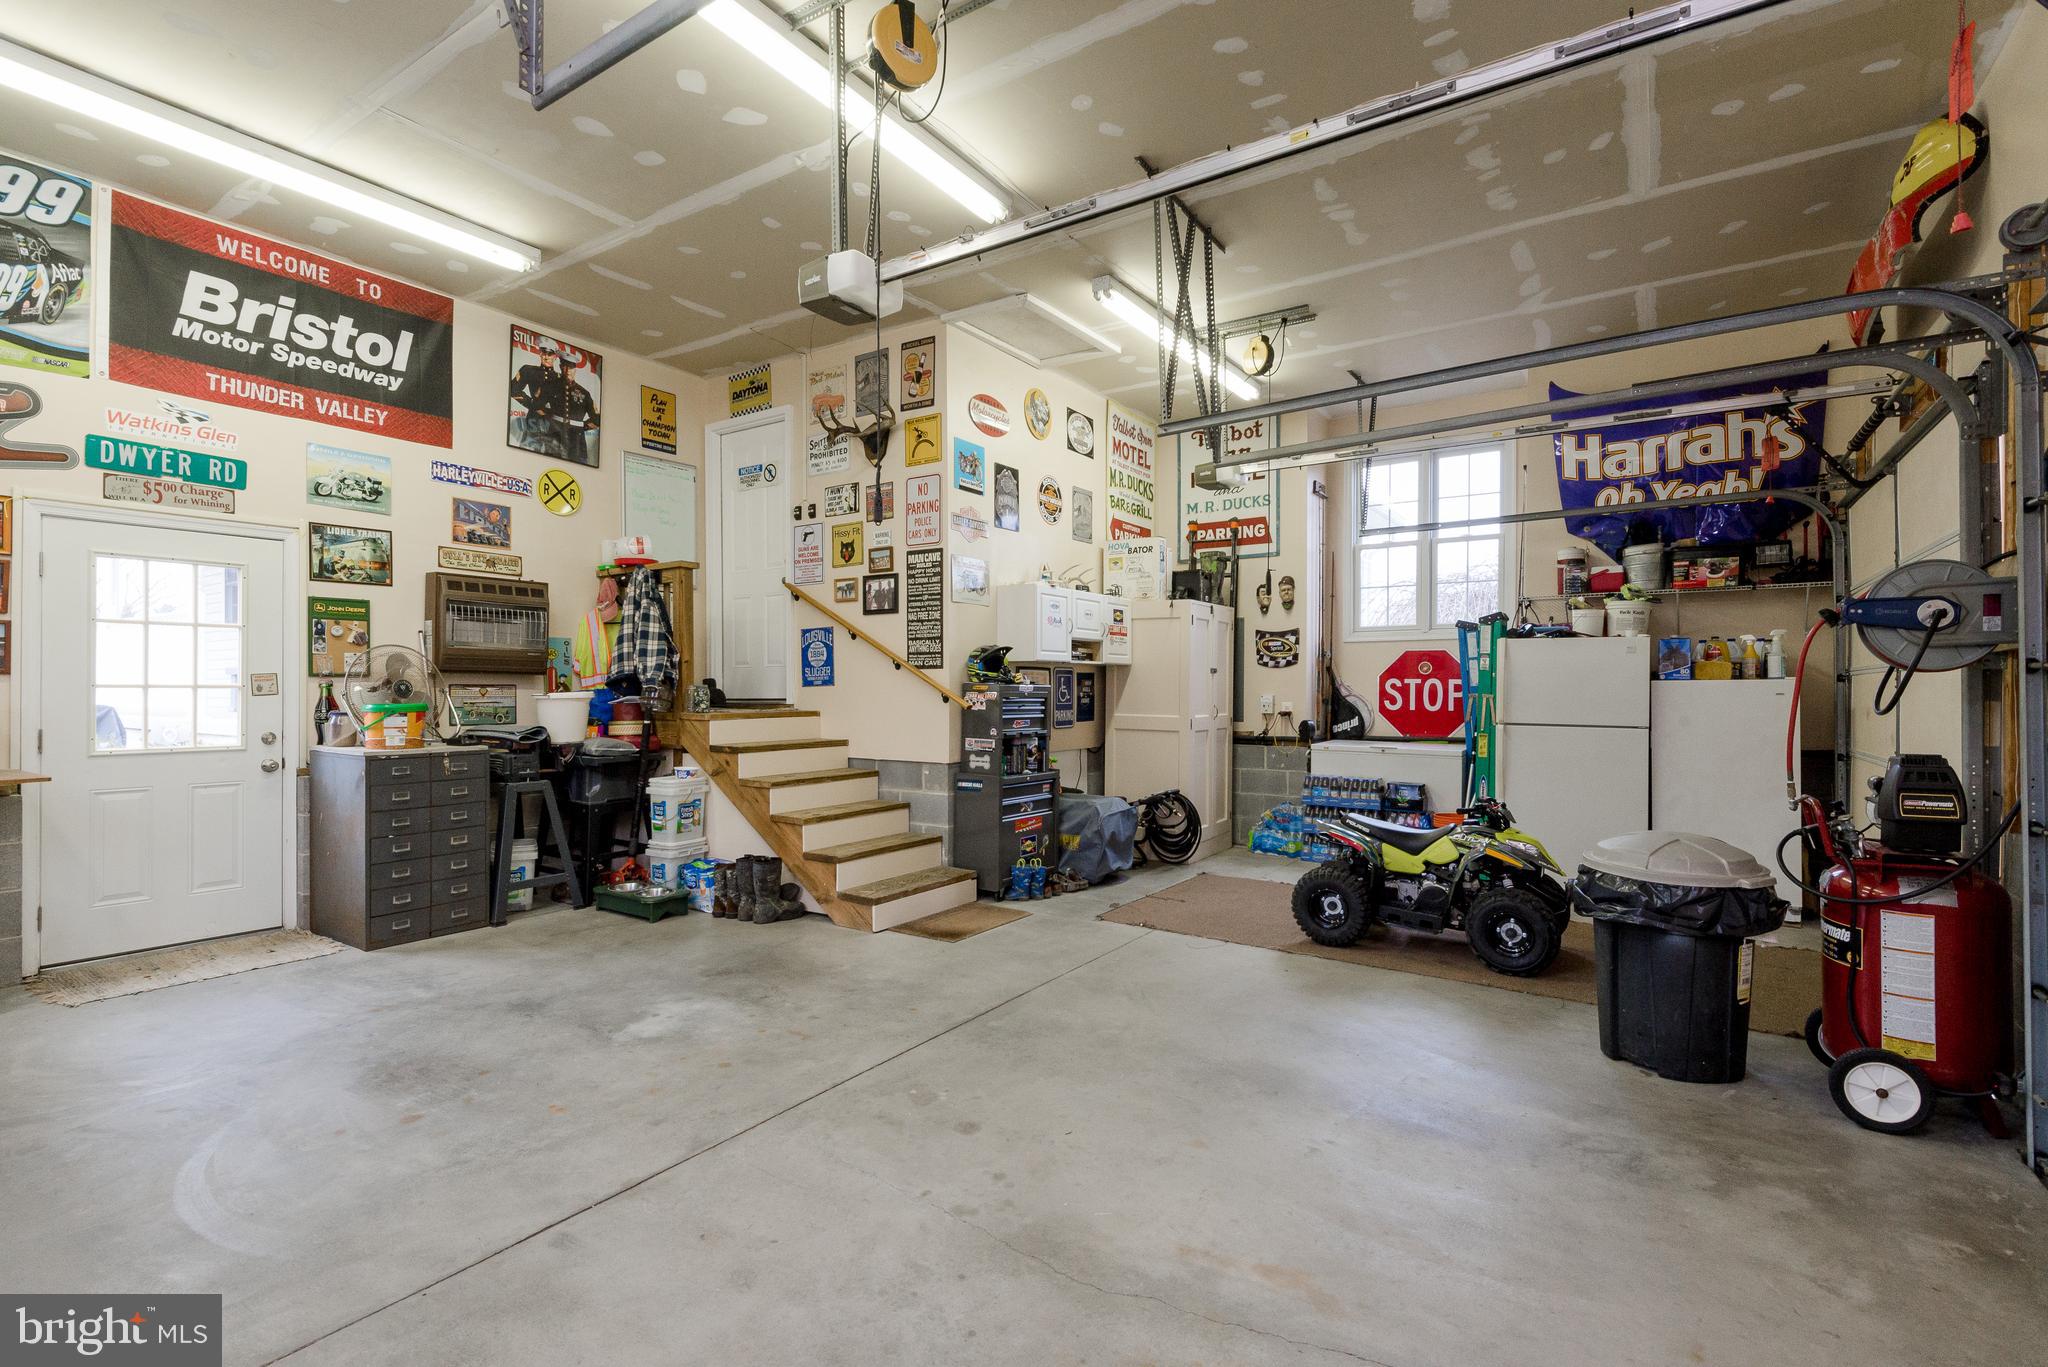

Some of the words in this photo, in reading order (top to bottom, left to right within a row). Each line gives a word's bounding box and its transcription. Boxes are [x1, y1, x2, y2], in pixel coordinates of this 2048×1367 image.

[51, 262, 82, 284] Aflac
[216, 234, 330, 284] WELCOME
[356, 278, 382, 300] TO
[179, 270, 414, 372] Bristol
[513, 330, 536, 347] STILL
[172, 318, 264, 355] Motor
[270, 343, 404, 391] Speedway
[732, 382, 768, 400] DAYTONA
[206, 372, 304, 410] THUNDER
[315, 397, 389, 426] VALLEY
[652, 407, 666, 415] LIKE
[971, 402, 1010, 425] Motorcycles
[107, 409, 192, 435] Watkins
[197, 425, 237, 444] Glen
[642, 419, 676, 433] CHAMPION
[109, 425, 236, 449] INTERNATIONAL
[648, 429, 671, 439] TODAY
[1191, 420, 1263, 448] Tbot
[810, 447, 848, 460] PROHIBITED
[1112, 436, 1151, 470] MOTEL
[100, 440, 192, 476] DWYER
[209, 459, 237, 483] RD
[432, 464, 504, 489] HARLEYVILLE
[740, 465, 760, 475] NOTICE
[180, 484, 224, 500] Charge
[543, 483, 549, 495] R
[569, 489, 575, 500] R
[917, 482, 928, 496] NO
[1127, 475, 1153, 502] DUCKS
[174, 496, 187, 505] for
[191, 497, 230, 511] Whining
[907, 499, 939, 515] PARKING
[1223, 494, 1271, 511] DUCKS
[914, 517, 932, 526] POLICE
[327, 526, 356, 537] LIONEL
[357, 529, 387, 539] TRAINS
[834, 530, 850, 538] Hissy
[909, 529, 921, 539] CARS
[924, 528, 936, 537] ONLY
[1108, 542, 1130, 551] HOVA
[1127, 545, 1153, 554] BATOR
[908, 553, 924, 564] MAN
[925, 552, 941, 562] CAVE
[908, 612, 917, 620] NAG
[918, 611, 928, 619] FREE
[929, 611, 940, 619] ZONE
[801, 629, 832, 648] LOUISVILLE
[805, 667, 830, 677] SLUGGER
[1384, 678, 1463, 712] STOP
[1055, 709, 1073, 721] PARKING
[1333, 716, 1358, 733] prince
[680, 805, 694, 814] Fresh
[681, 810, 693, 818] Step
[1346, 819, 1370, 833] POLARIS
